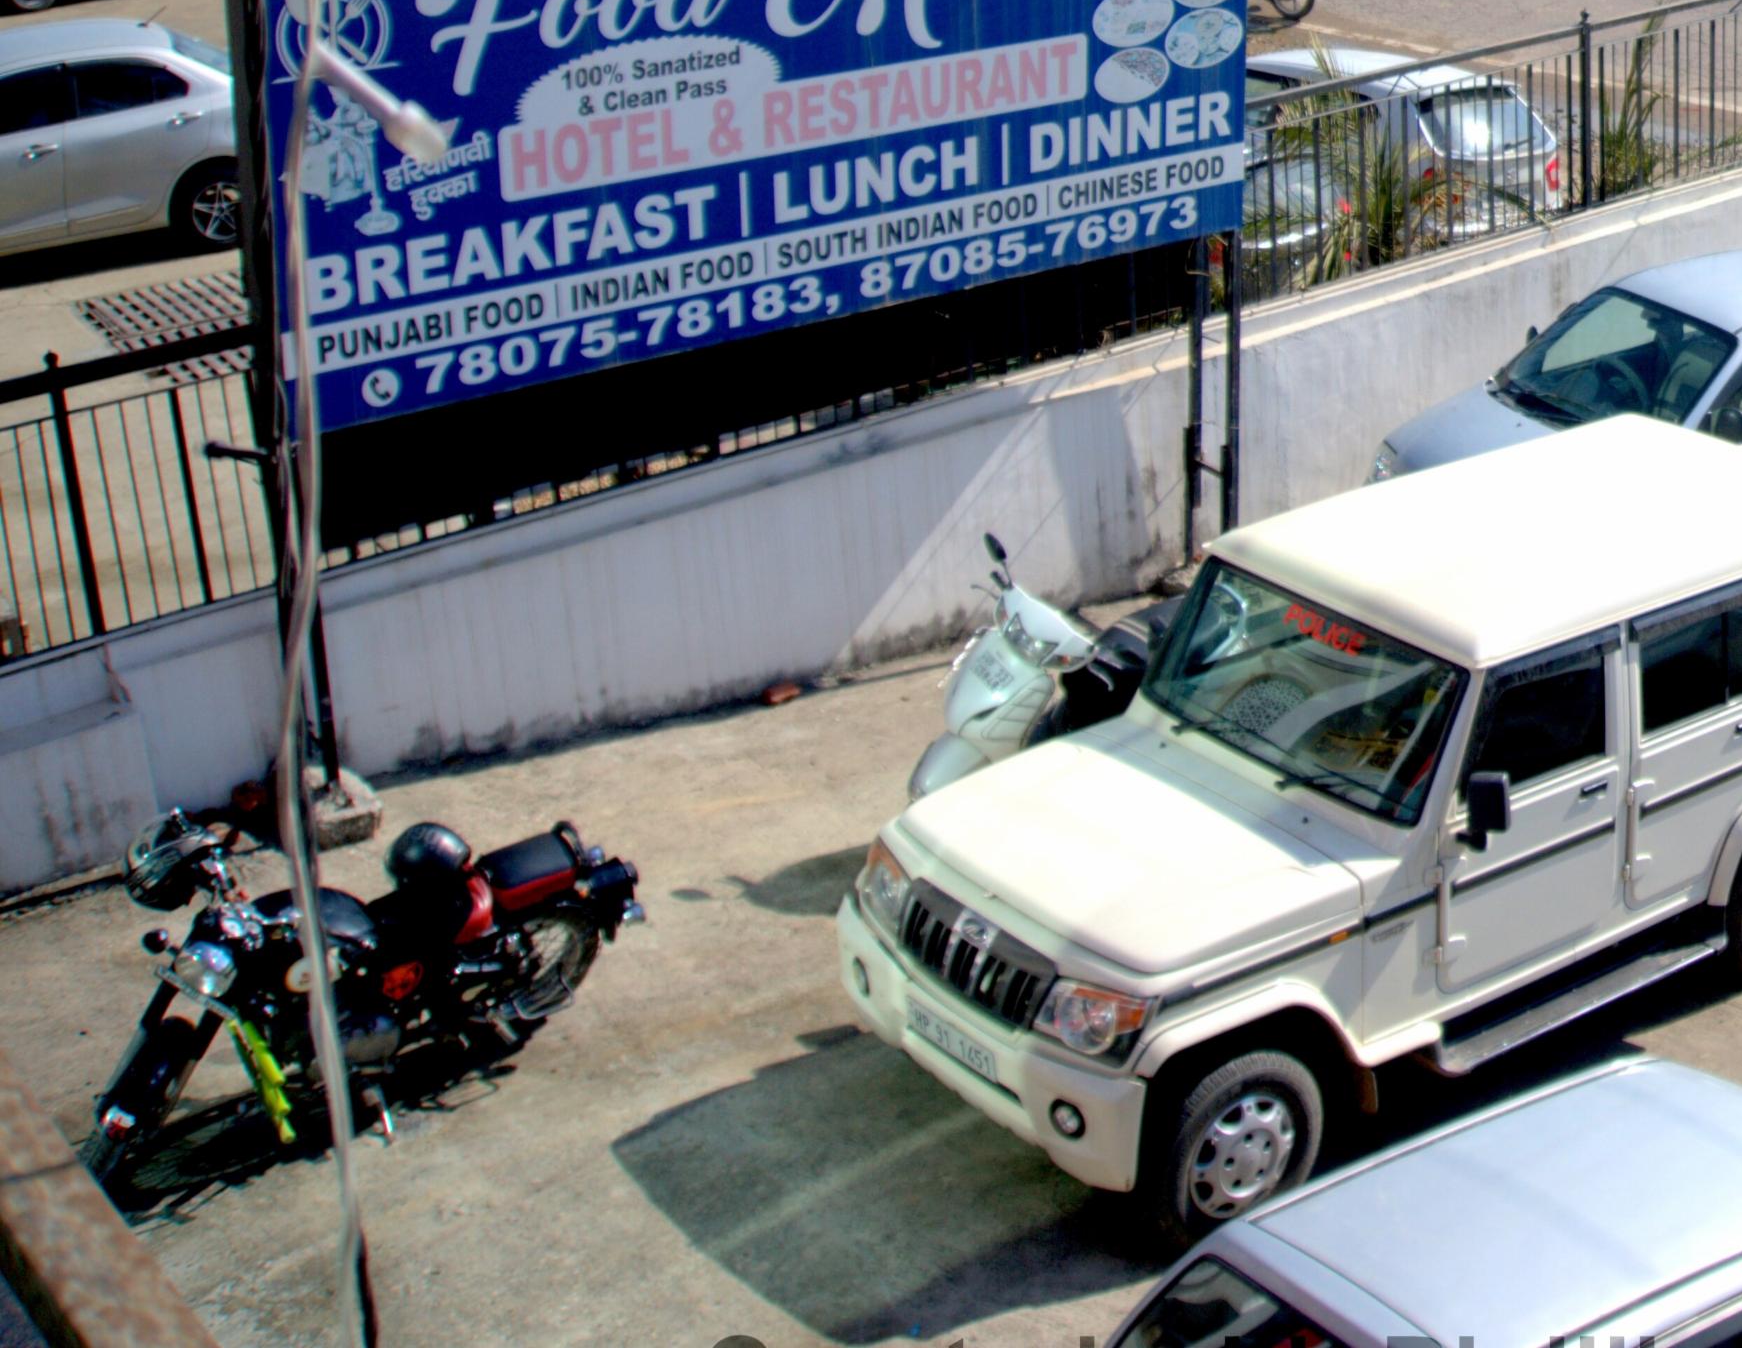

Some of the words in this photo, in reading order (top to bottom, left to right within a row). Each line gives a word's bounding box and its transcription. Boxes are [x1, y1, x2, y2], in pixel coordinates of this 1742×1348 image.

[511, 107, 689, 192] HOTEL
[707, 98, 744, 158] &
[763, 42, 1079, 149] RESTAURANT
[561, 62, 623, 91] 100%
[632, 45, 741, 80] Sanatized
[578, 95, 594, 116] &
[603, 88, 667, 112] Clean
[675, 79, 727, 101] Pass
[305, 184, 716, 316] BREAKFAST
[773, 136, 979, 225] LUNCH
[1030, 91, 1231, 174] DINNER
[860, 196, 1199, 299] 87085-76973
[317, 313, 453, 365] PUNJABI
[464, 292, 544, 333] FOOD
[571, 270, 670, 313] INDIAN
[680, 250, 754, 292] FOOD
[777, 228, 868, 270] SOUTH
[877, 207, 964, 249] INDIAN
[972, 192, 1038, 229] FOOD
[1057, 173, 1158, 211] CHINESE
[1165, 155, 1224, 188] FOOD
[1283, 603, 1366, 657] POLICE
